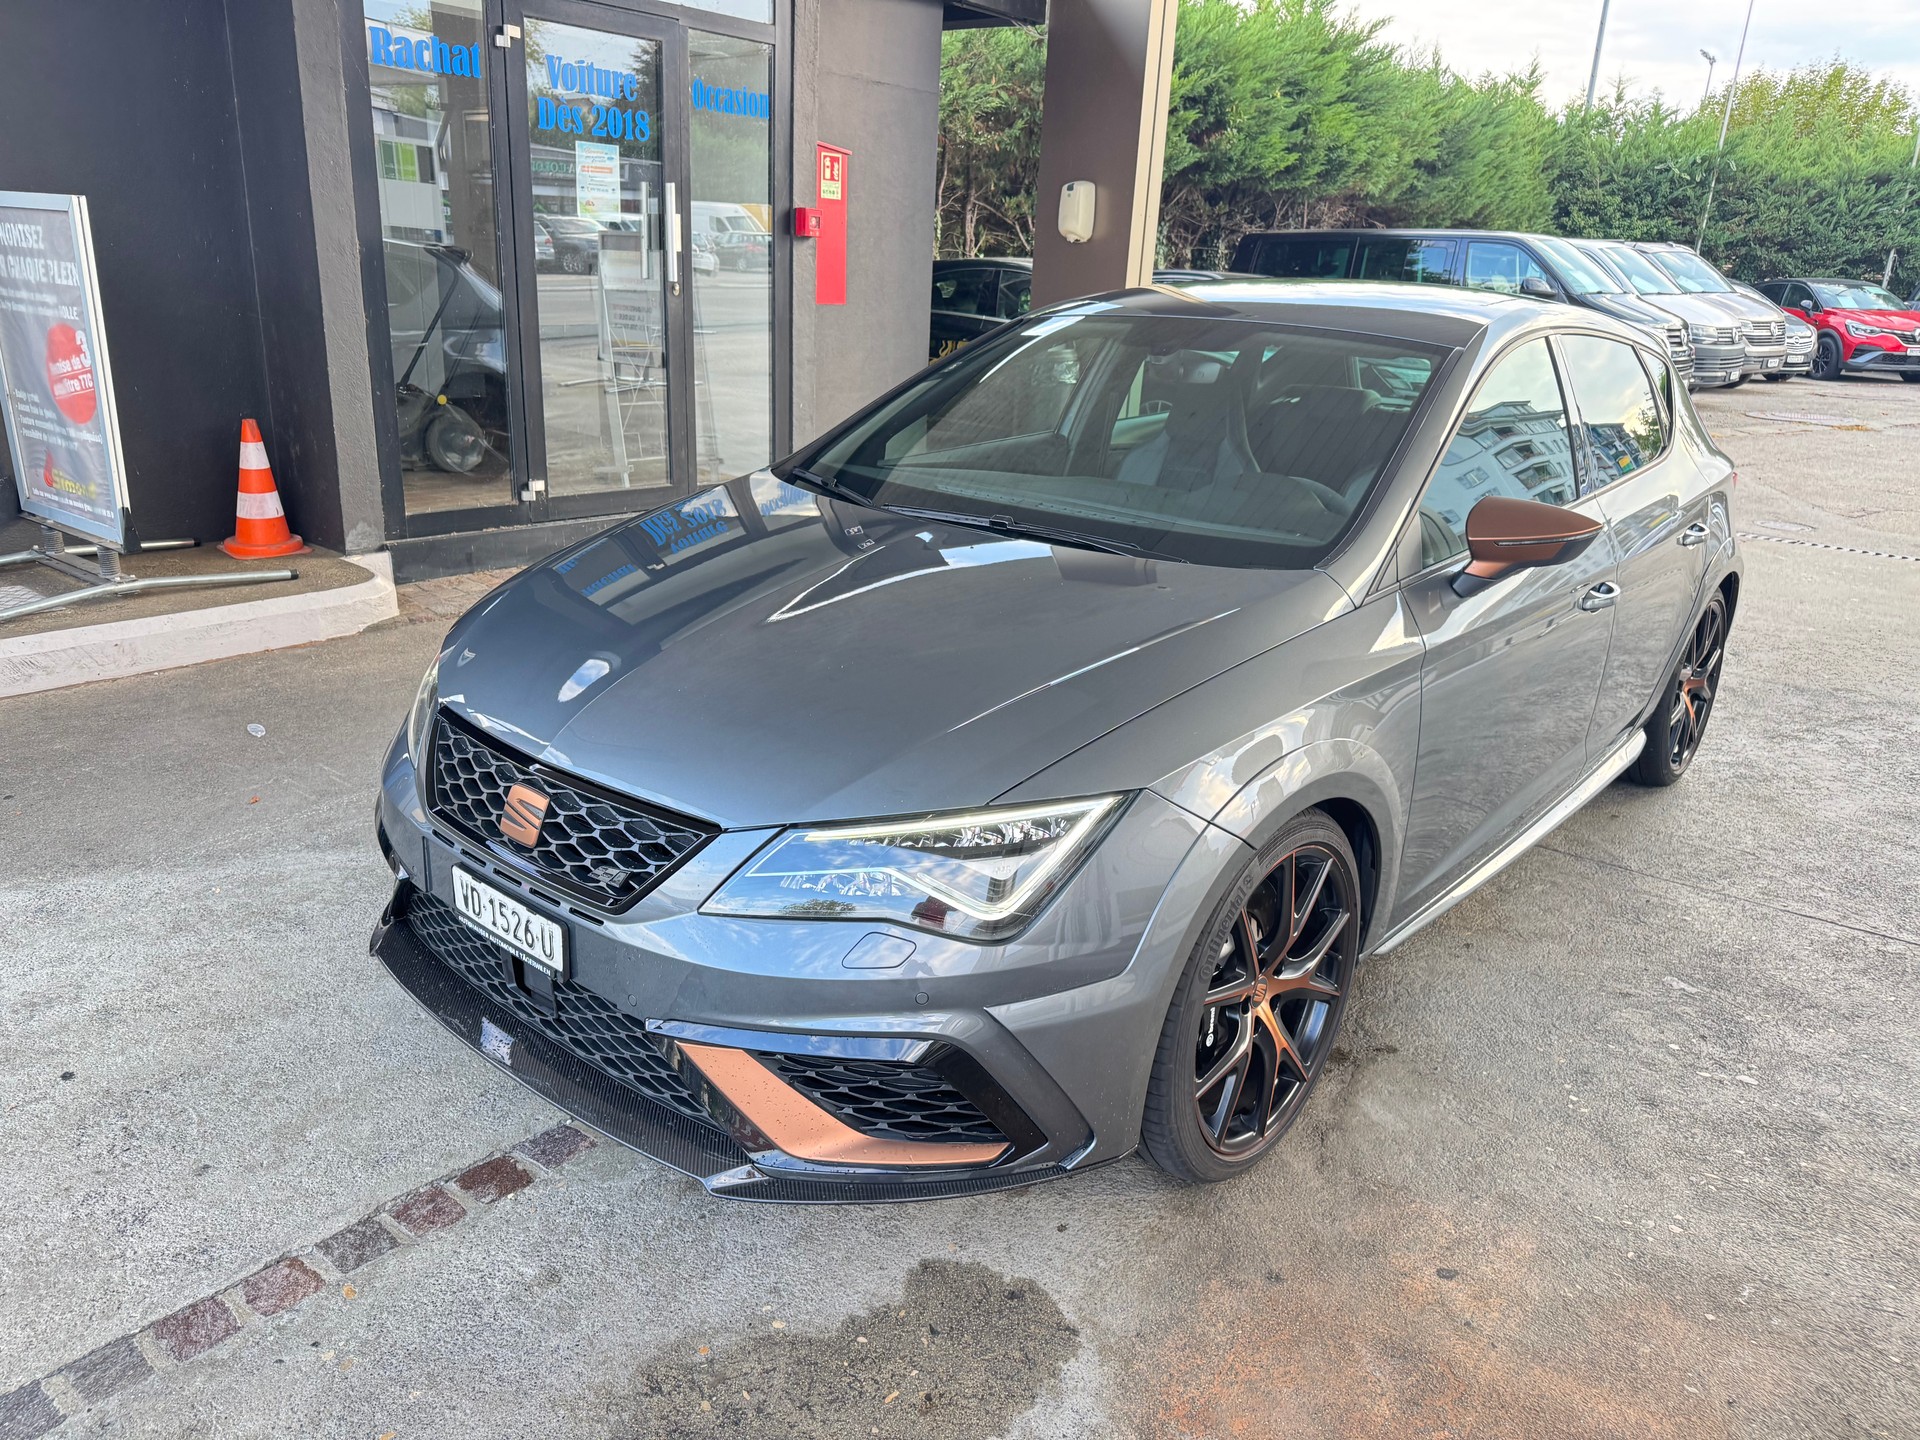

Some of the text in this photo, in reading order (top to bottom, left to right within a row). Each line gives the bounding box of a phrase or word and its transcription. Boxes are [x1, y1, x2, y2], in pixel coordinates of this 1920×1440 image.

[369, 26, 482, 79] Rachat
[545, 54, 638, 102] Voiture
[691, 77, 770, 120] Occasion
[537, 97, 650, 142] Dès 2018
